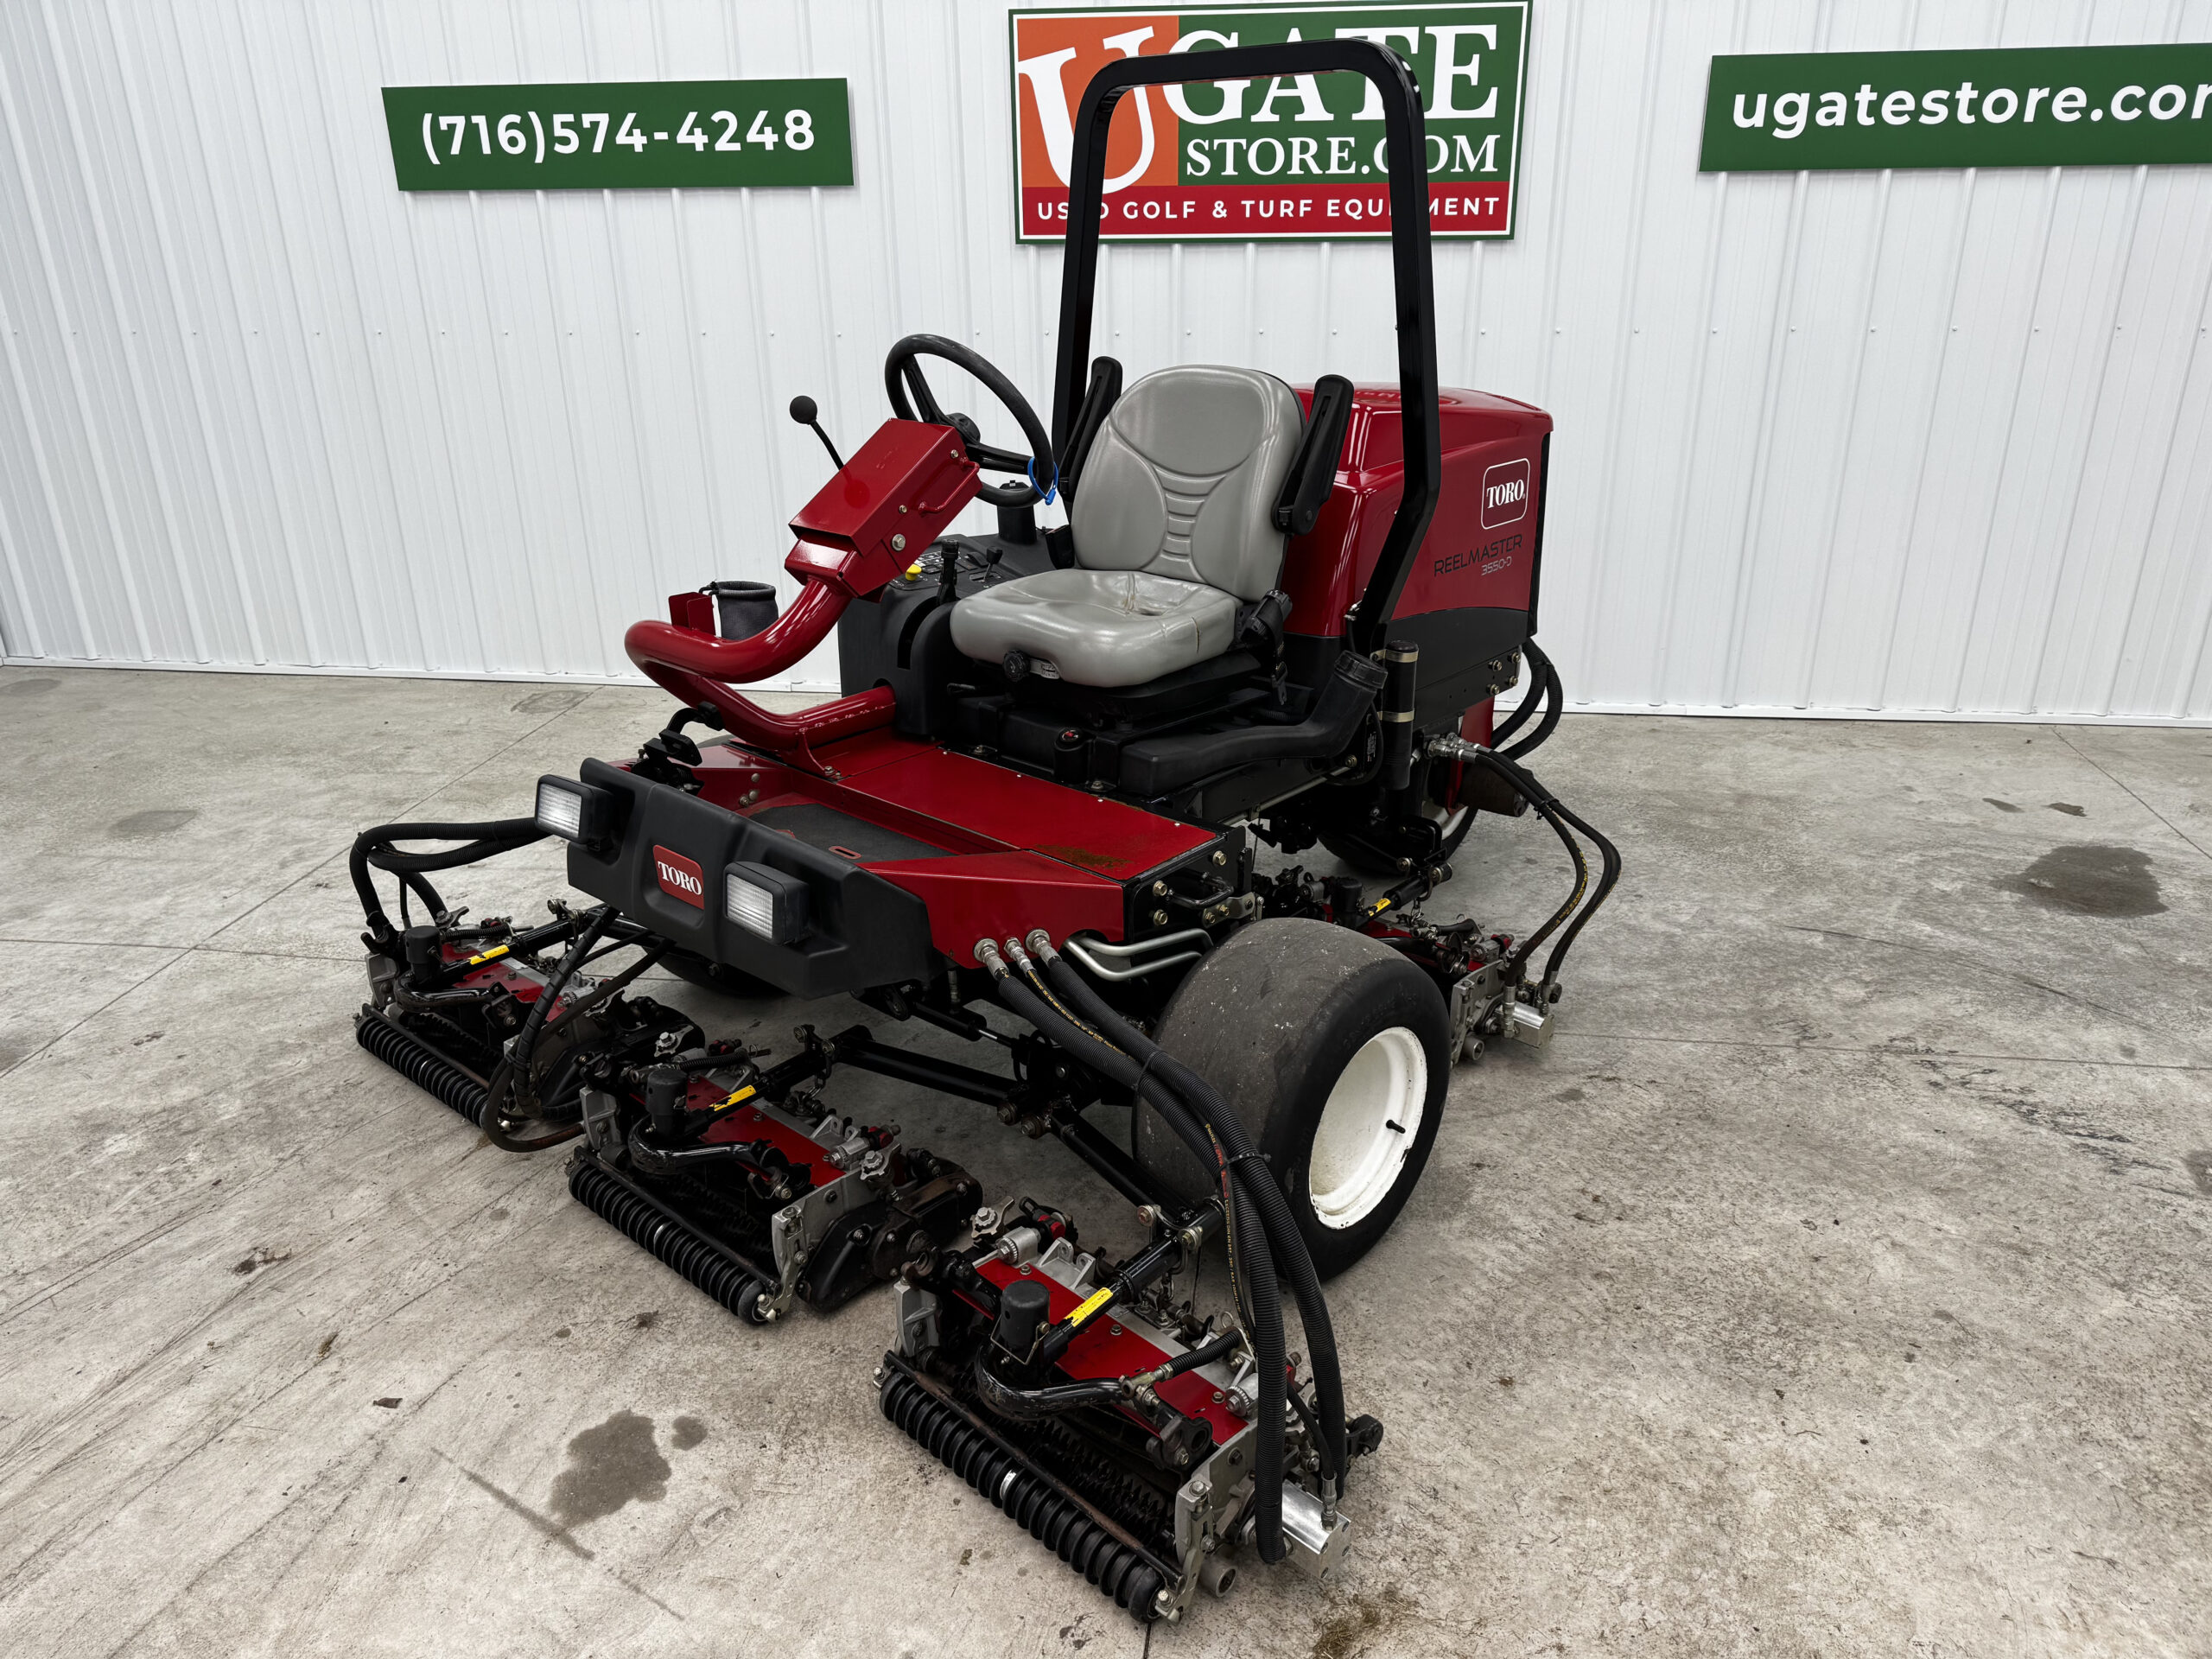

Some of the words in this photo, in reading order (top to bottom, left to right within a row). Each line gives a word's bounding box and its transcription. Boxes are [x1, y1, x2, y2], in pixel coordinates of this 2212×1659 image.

[422, 109, 815, 165] (716)574-4248
[1038, 201, 1109, 220] USD
[1123, 200, 1196, 219] GOLF
[1212, 200, 1228, 219] &
[1241, 199, 1313, 218] TURF
[1326, 196, 1500, 220] EQUMENT
[1486, 480, 1525, 509] TORO
[1433, 534, 1522, 577] REELMASTER
[658, 861, 702, 895] TORO
